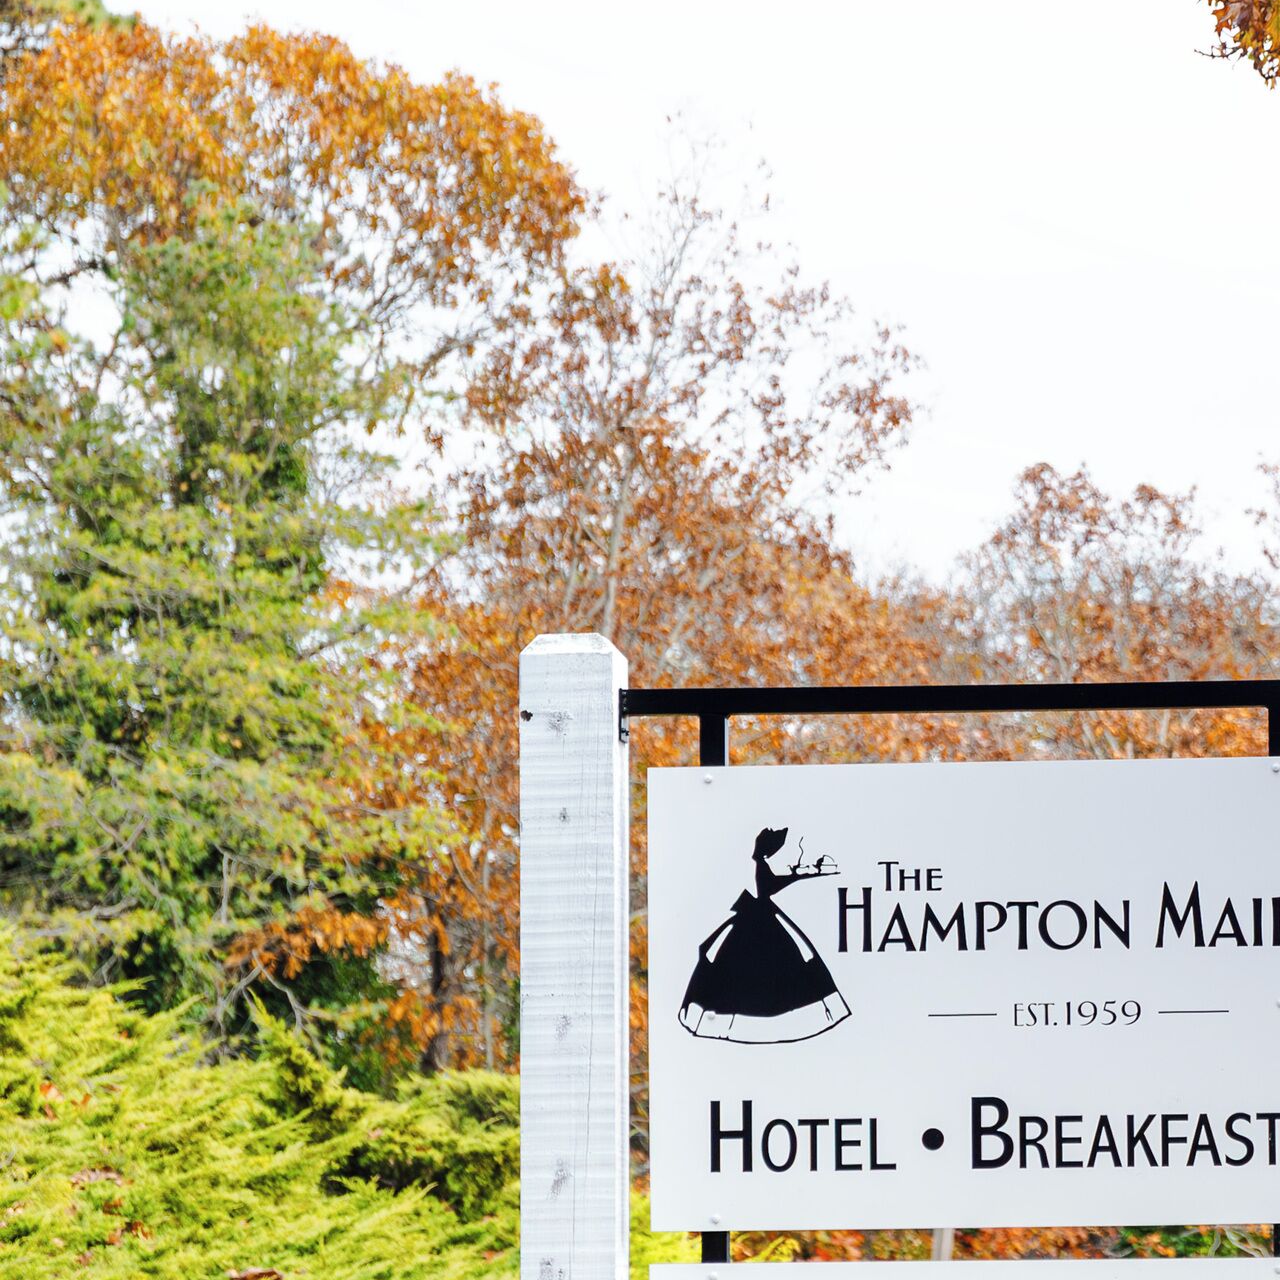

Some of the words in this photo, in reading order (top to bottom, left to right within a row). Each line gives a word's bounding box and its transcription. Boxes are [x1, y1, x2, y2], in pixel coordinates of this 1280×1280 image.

[878, 862, 943, 891] THE
[836, 886, 1132, 953] HAMPTON
[711, 1100, 896, 1172] HOTEL
